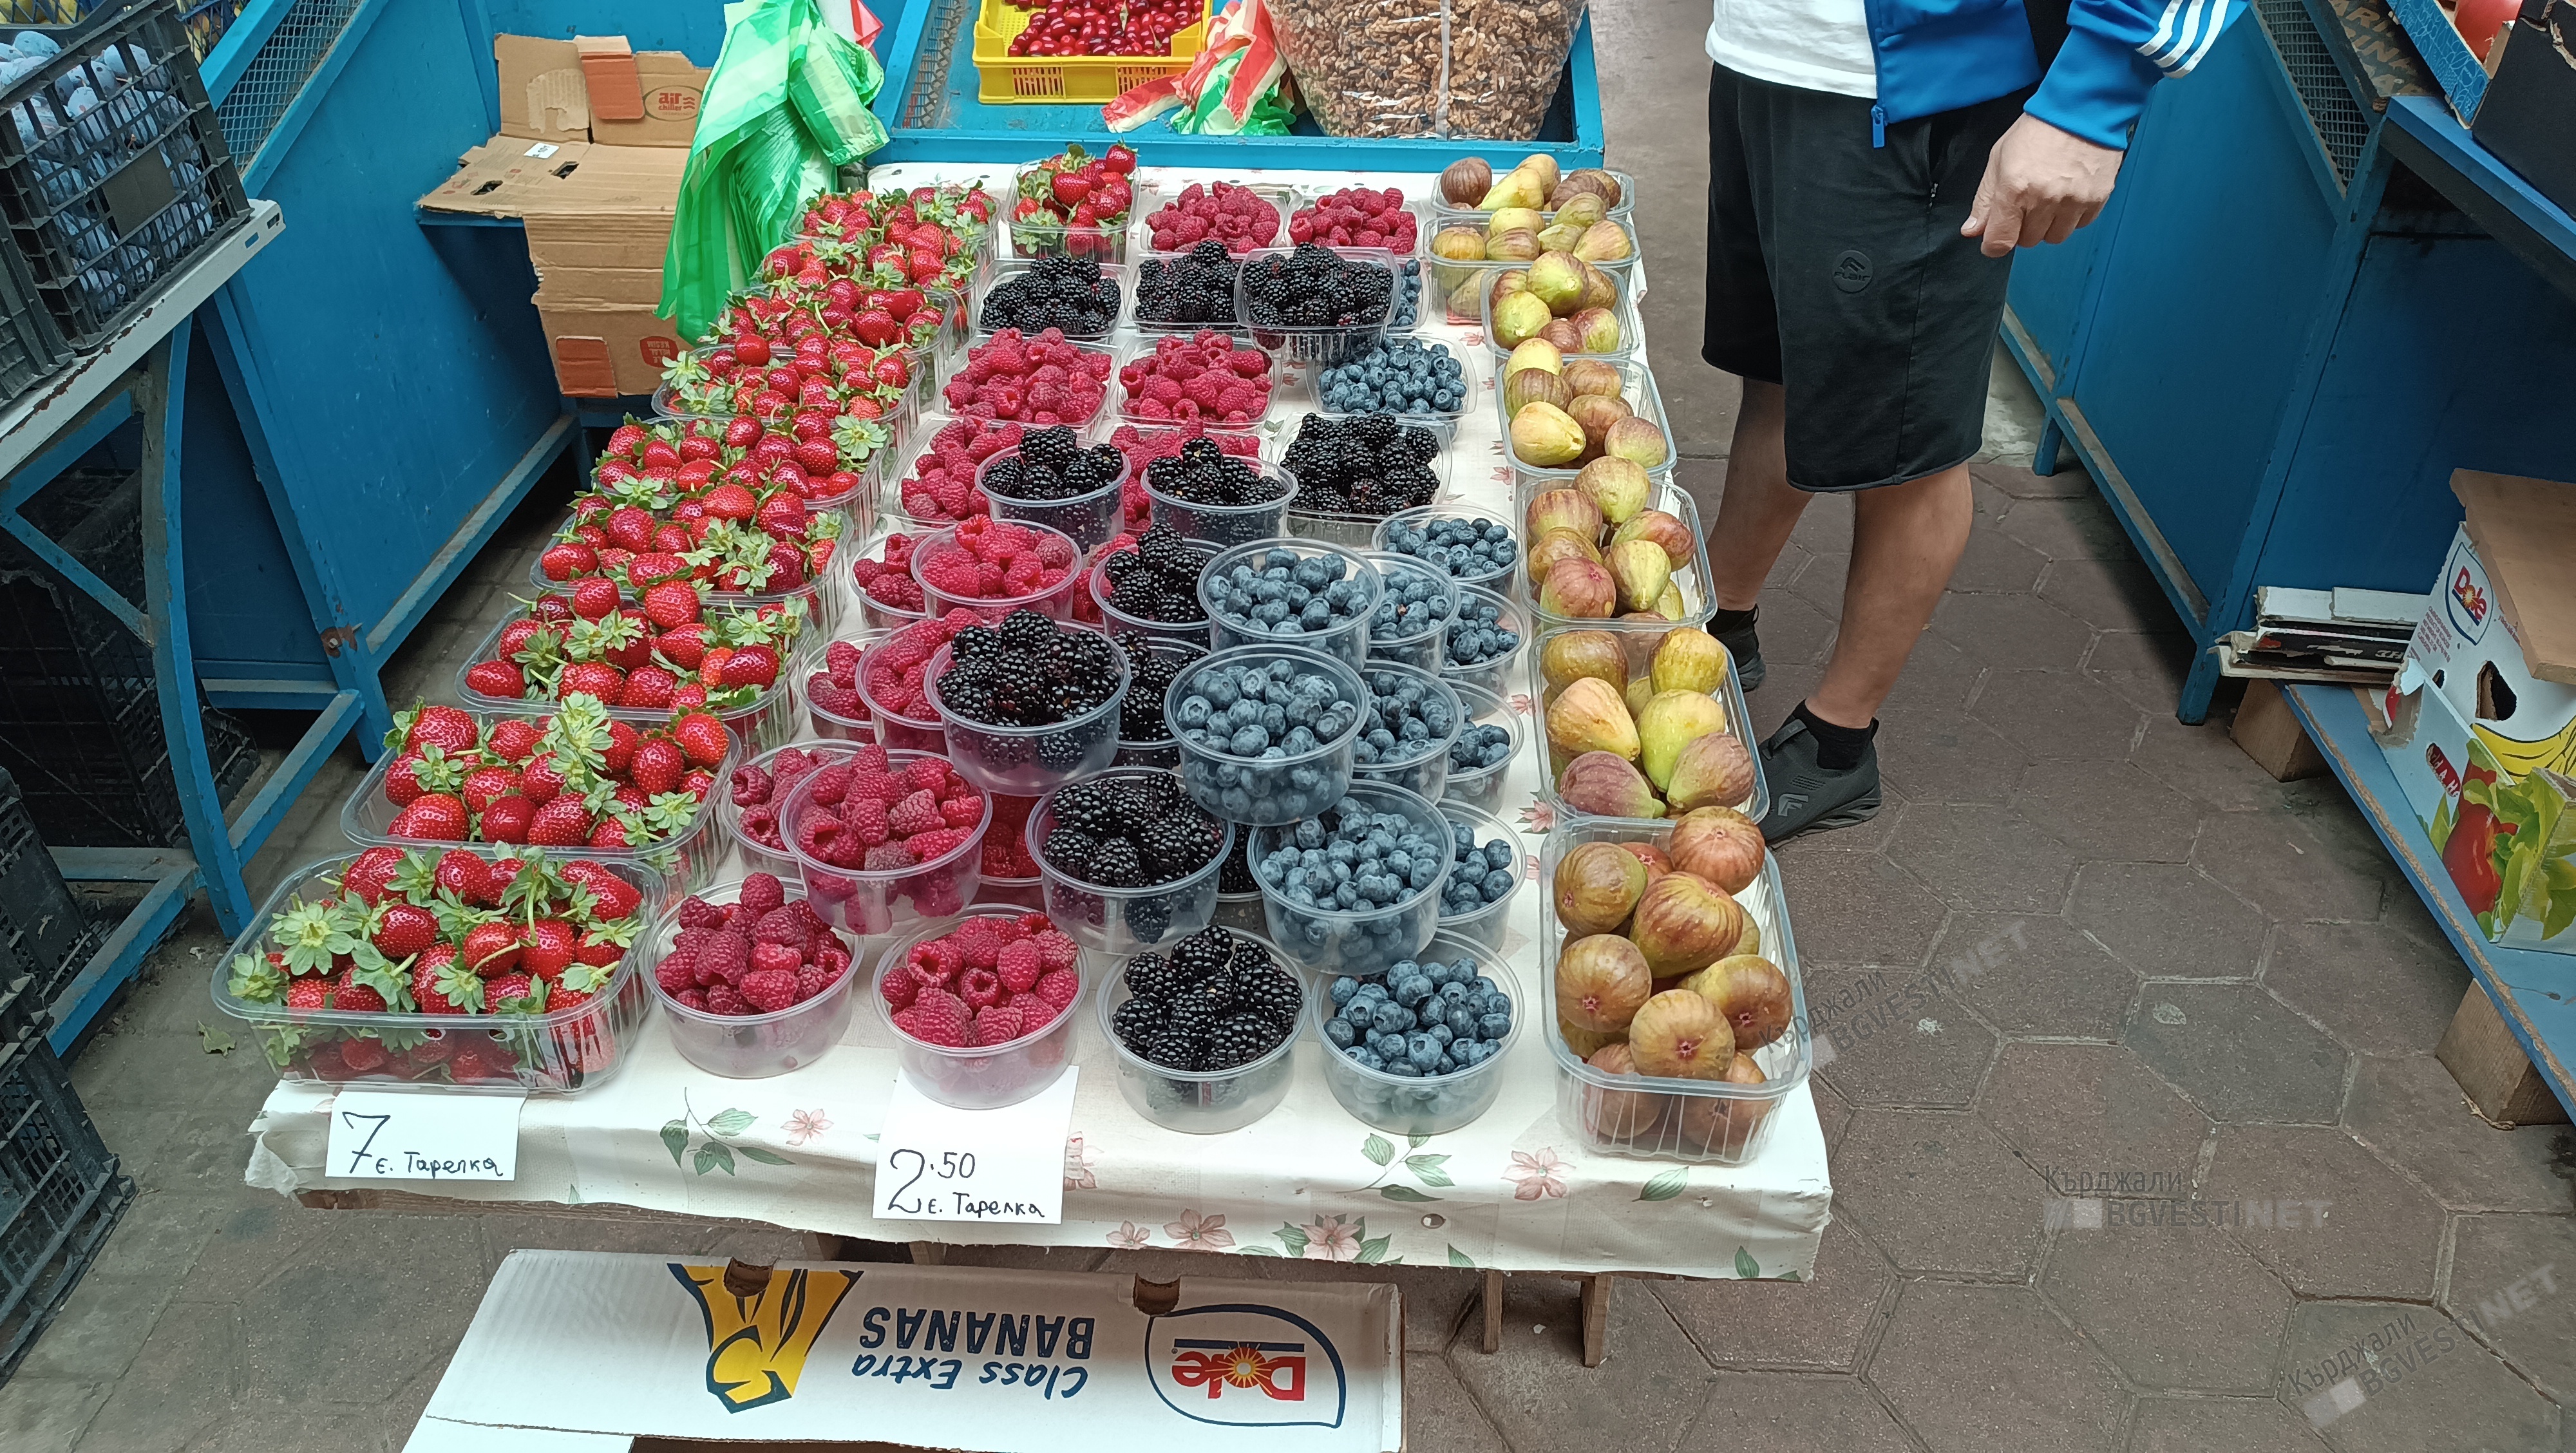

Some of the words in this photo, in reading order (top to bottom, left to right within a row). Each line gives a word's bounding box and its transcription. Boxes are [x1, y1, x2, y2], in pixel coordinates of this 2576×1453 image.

[658, 92, 682, 104] air
[2454, 565, 2487, 620] Dole
[404, 1151, 503, 1179] Тарелка
[952, 1192, 1045, 1218] Тарелка
[859, 1307, 1095, 1360] BANANAS
[851, 1354, 962, 1390] Extra
[979, 1362, 1088, 1400] Class
[1171, 1347, 1306, 1401] Dole
